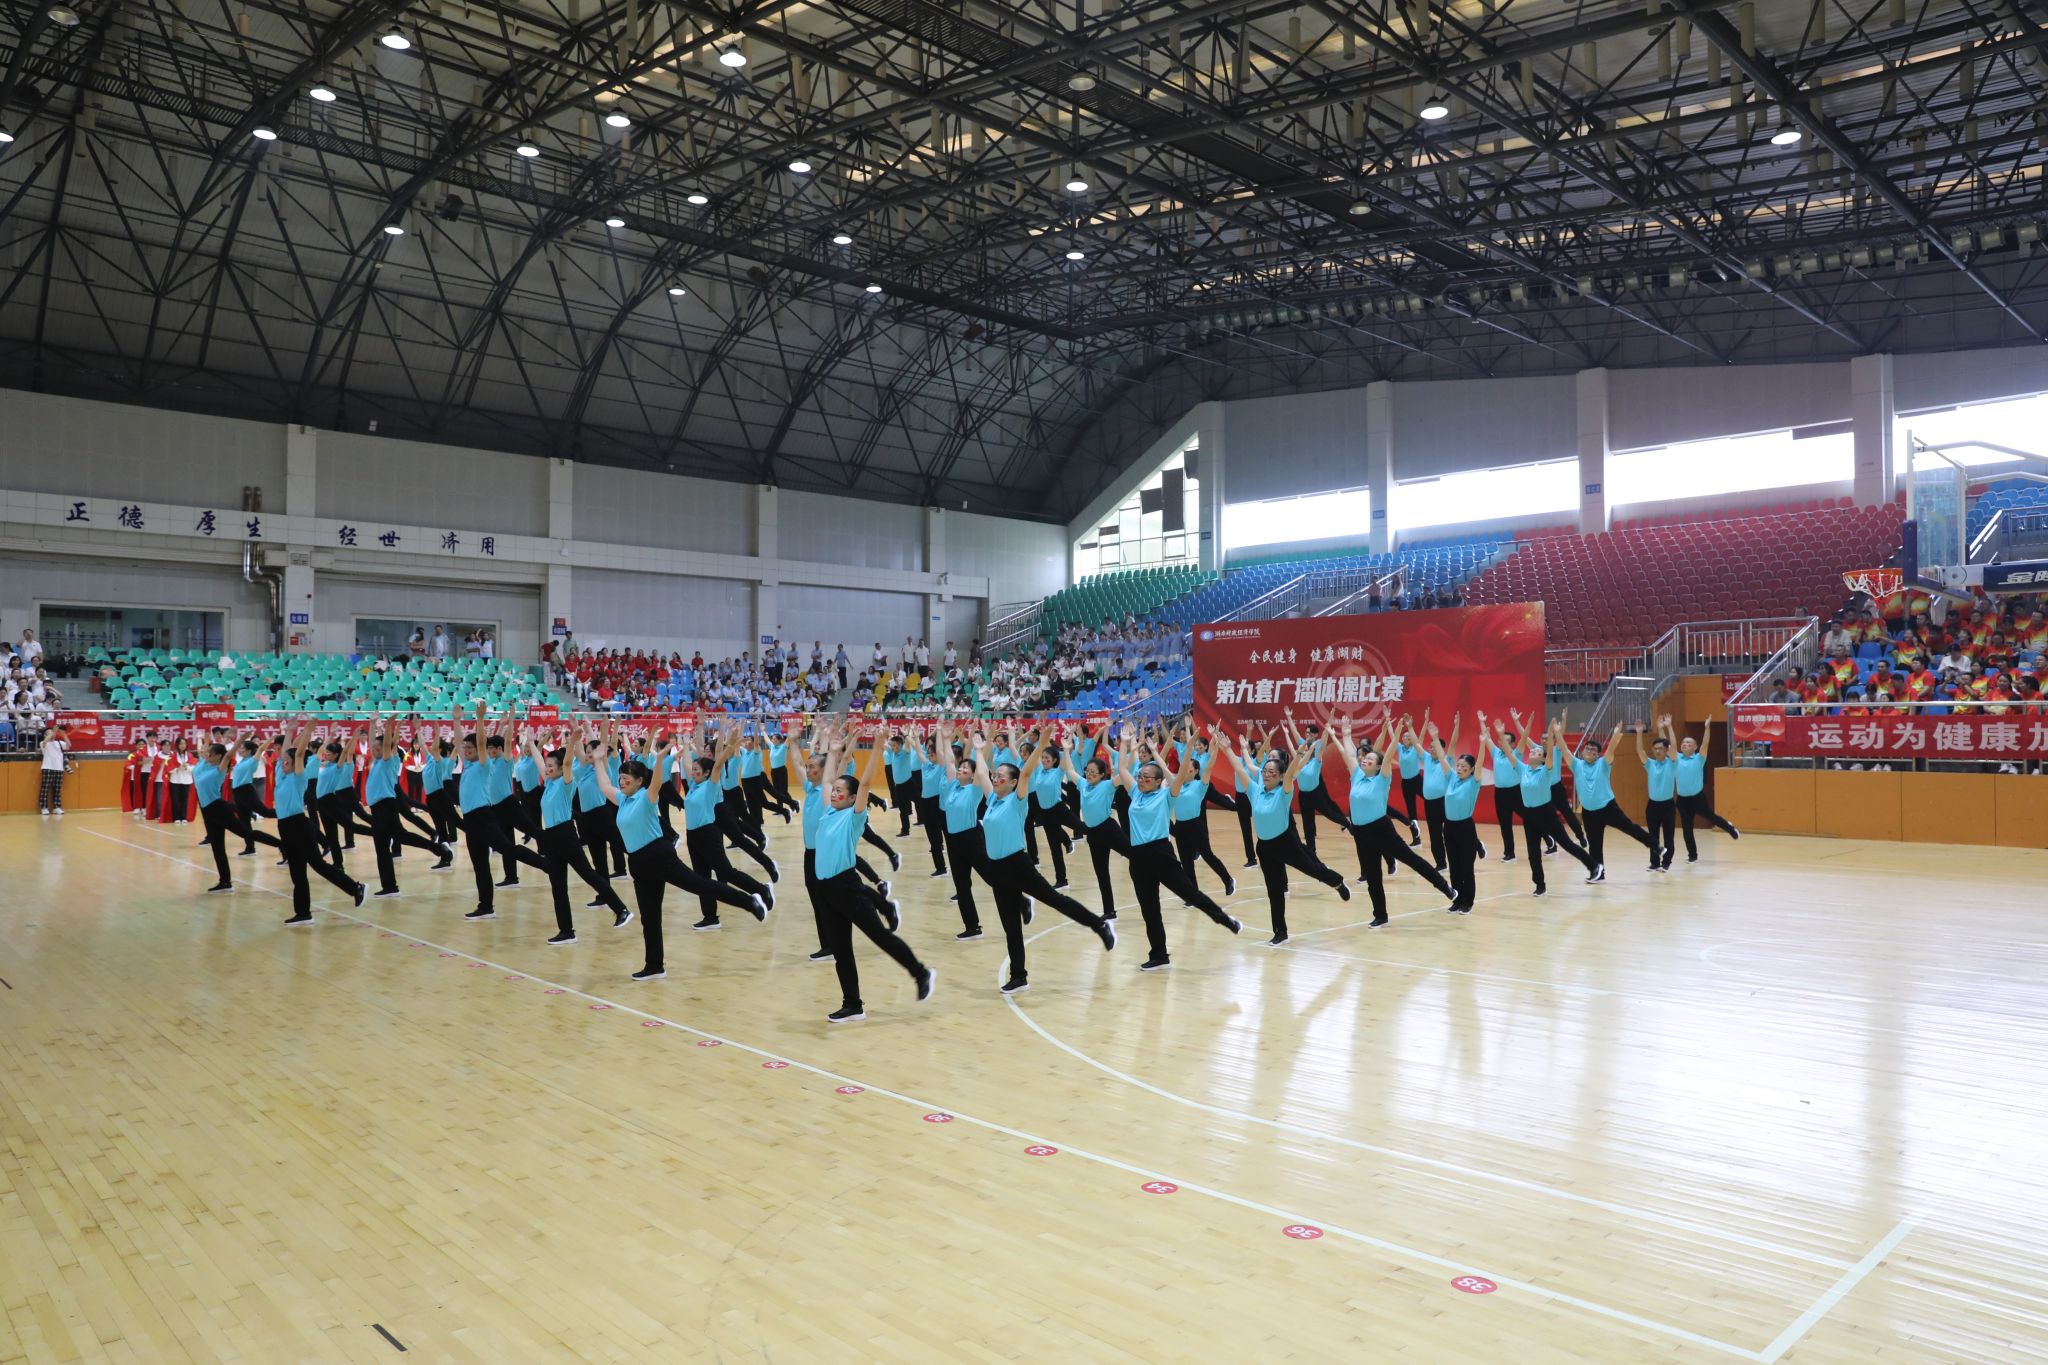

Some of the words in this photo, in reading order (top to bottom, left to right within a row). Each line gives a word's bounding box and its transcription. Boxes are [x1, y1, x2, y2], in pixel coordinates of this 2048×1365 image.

[1249, 648, 1297, 664] 全民健身
[1310, 645, 1364, 663] 健康湖财
[1215, 674, 1405, 705] 第九套广播体操比赛
[1029, 1146, 1055, 1156] 32
[1145, 1182, 1175, 1193] 34
[1286, 1226, 1319, 1238] 36
[1457, 1277, 1492, 1292] 38
